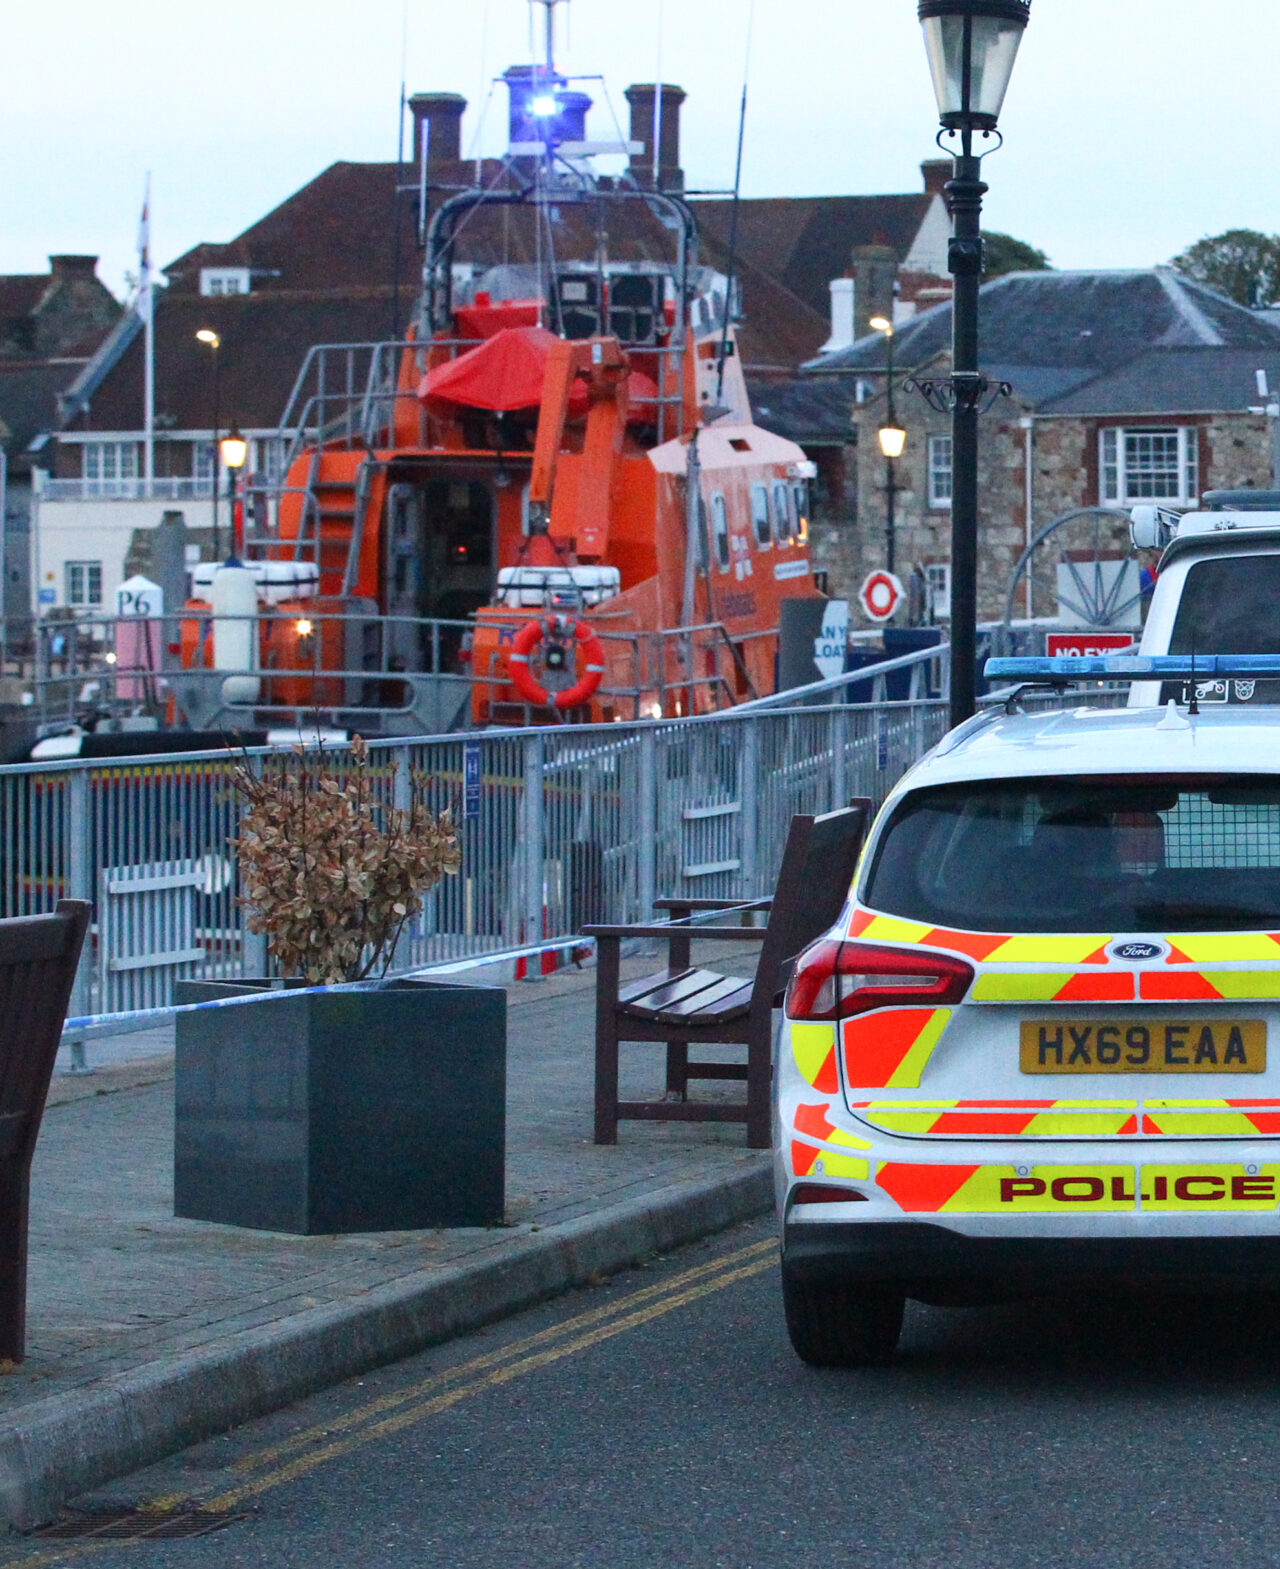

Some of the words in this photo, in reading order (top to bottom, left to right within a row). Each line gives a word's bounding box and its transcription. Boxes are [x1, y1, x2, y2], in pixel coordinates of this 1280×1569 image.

[118, 591, 151, 616] P6
[1122, 944, 1152, 956] Ford
[1037, 1026, 1150, 1065] HX69
[1164, 1025, 1247, 1065] EAA
[1000, 1176, 1276, 1202] POLICE
